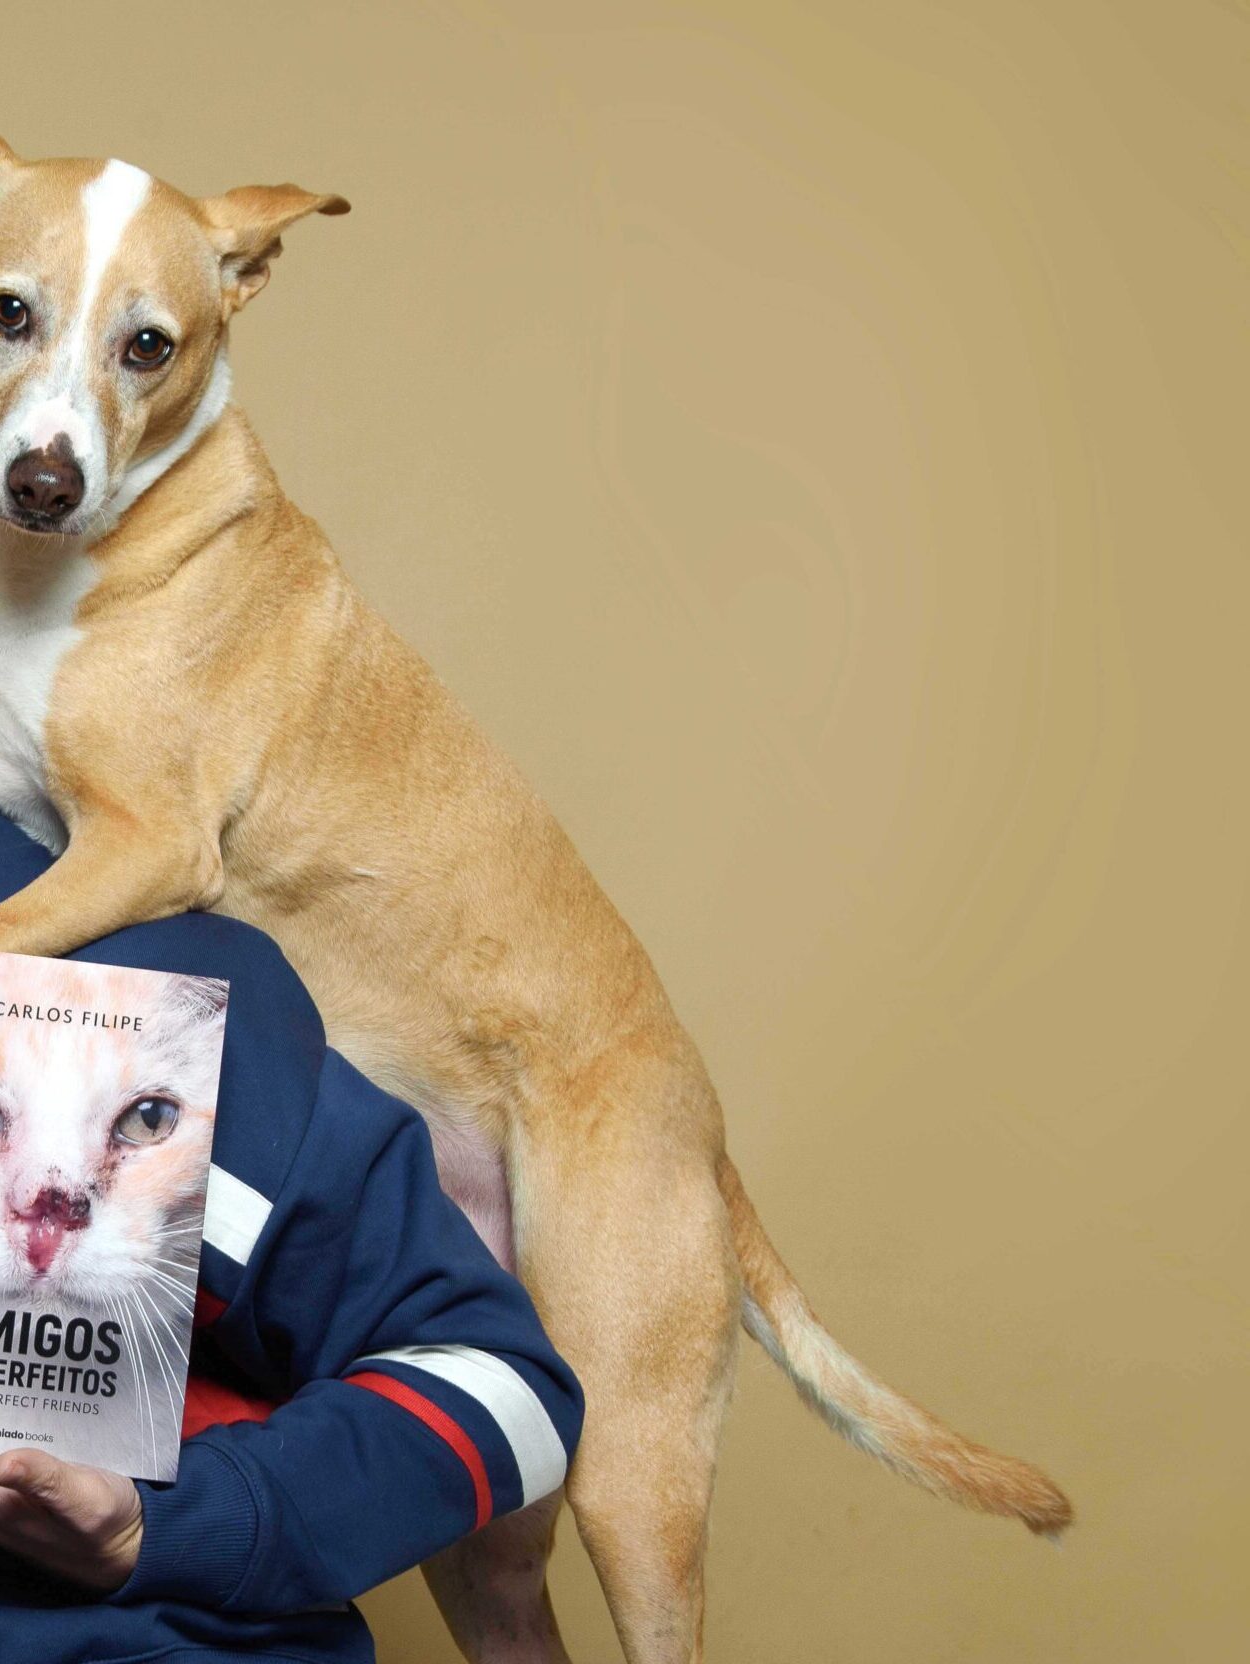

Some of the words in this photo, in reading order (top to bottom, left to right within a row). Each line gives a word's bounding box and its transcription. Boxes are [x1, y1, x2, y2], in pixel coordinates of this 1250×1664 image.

[82, 1011, 143, 1032] FILIPE
[42, 1398, 100, 1415] FRIENDS
[25, 1431, 54, 1443] books
